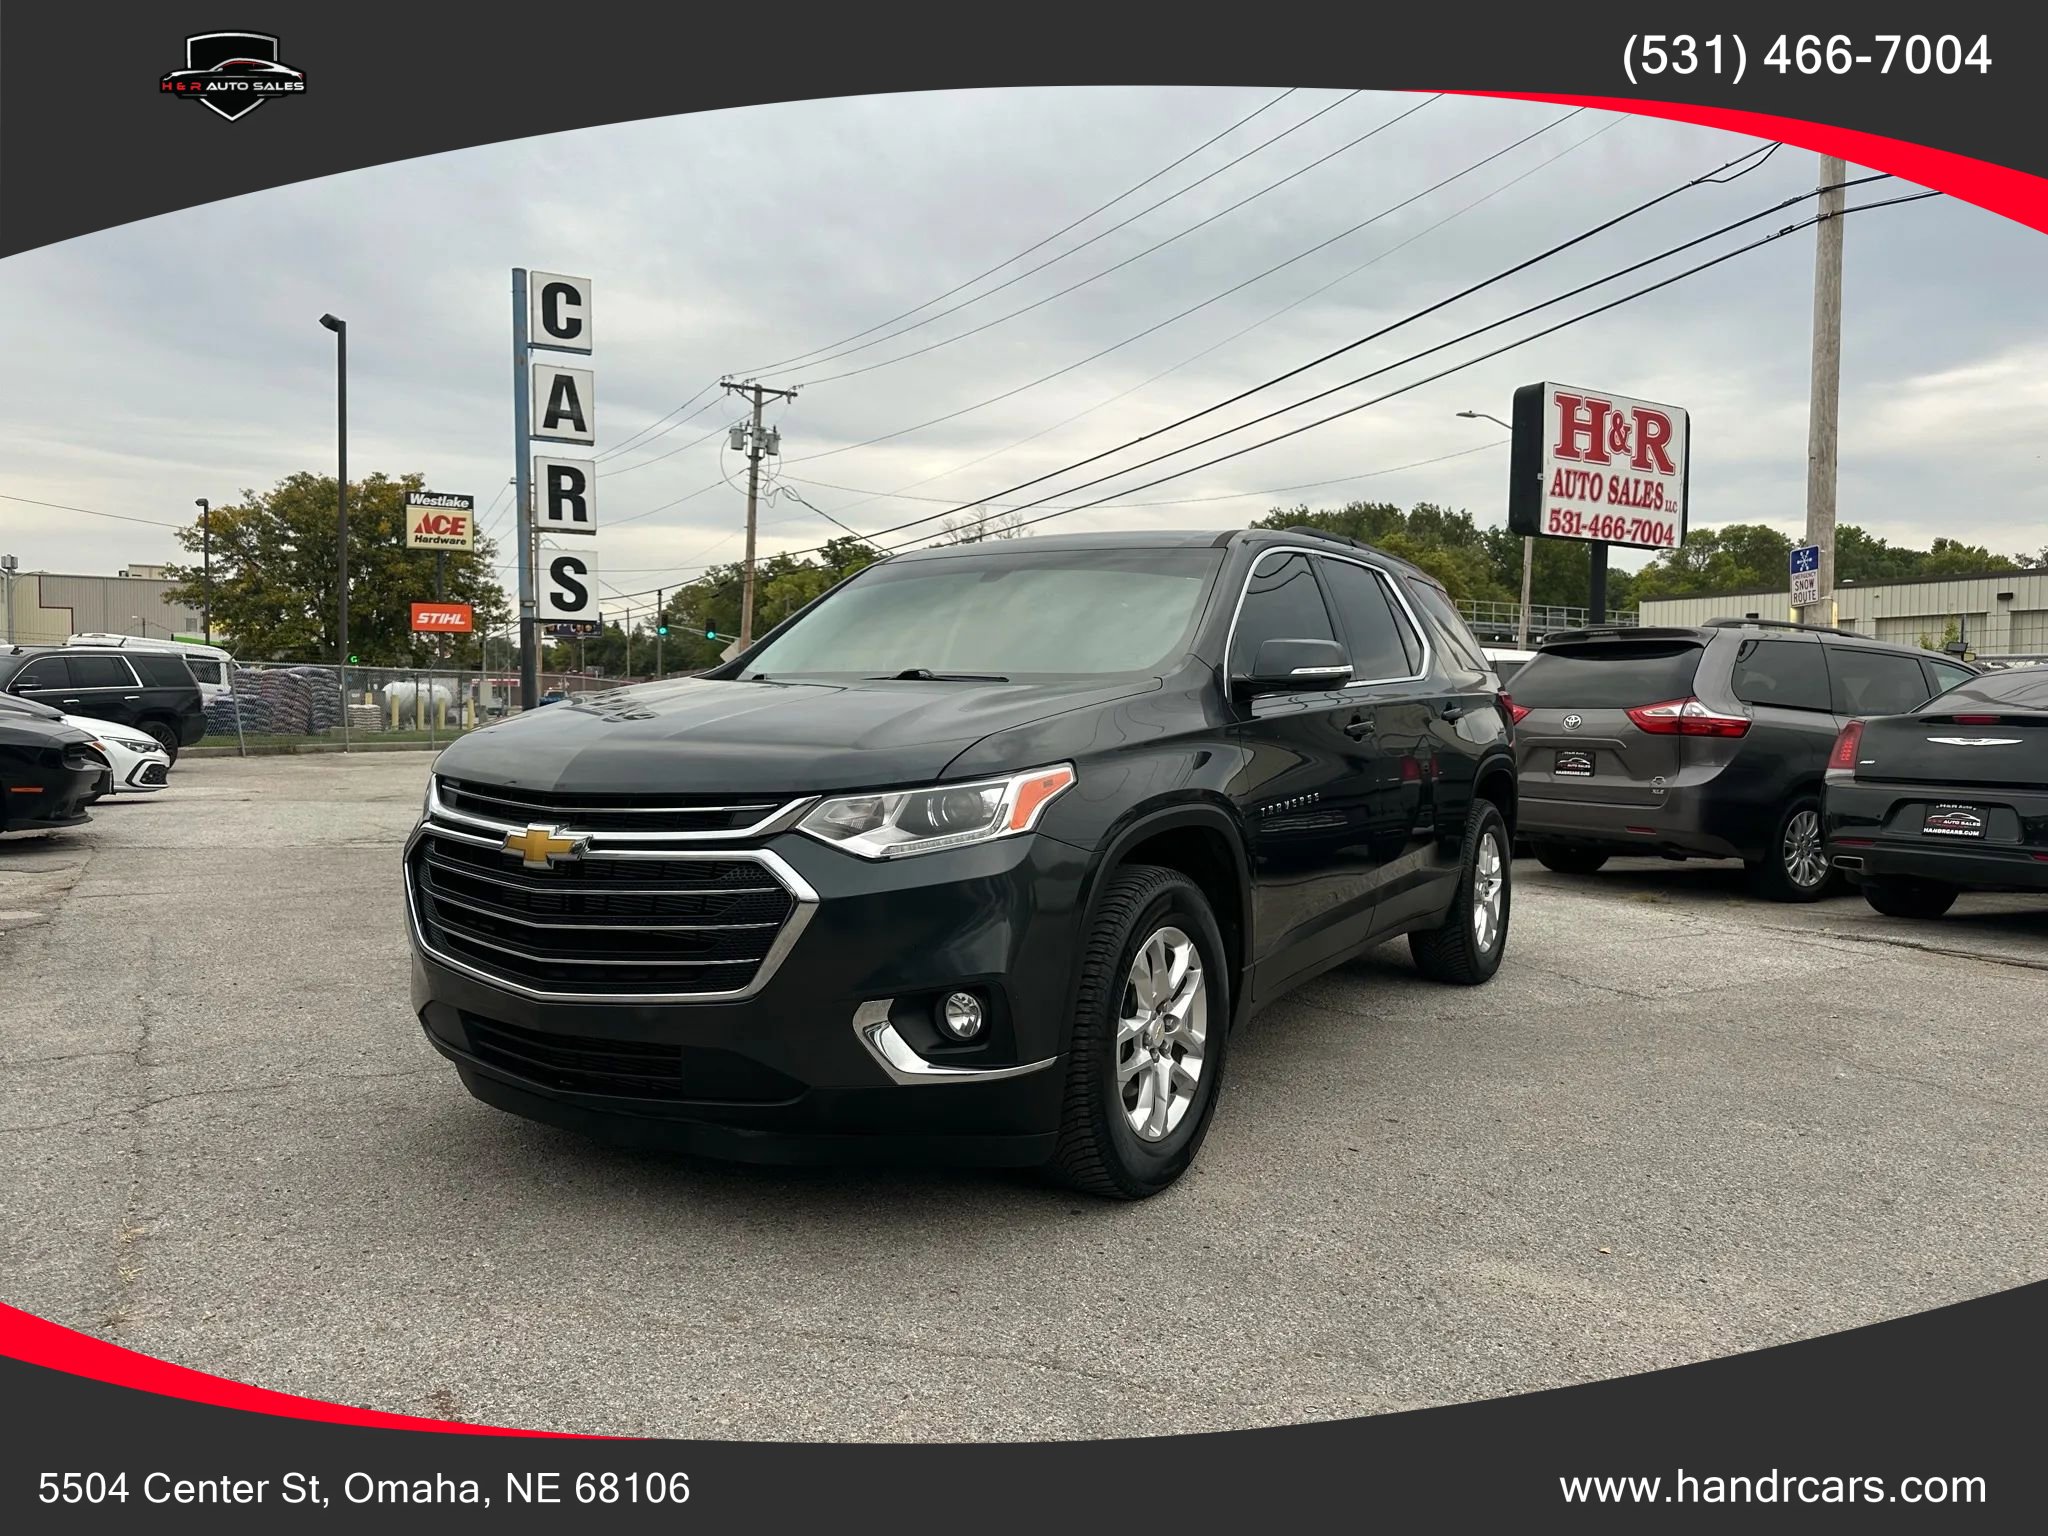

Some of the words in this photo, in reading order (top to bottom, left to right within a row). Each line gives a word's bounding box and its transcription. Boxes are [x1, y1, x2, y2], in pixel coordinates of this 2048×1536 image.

[1553, 391, 1676, 476] H&R
[1550, 467, 1604, 502] AUTO
[1607, 475, 1664, 511] SALES
[1665, 501, 1678, 514] LLC
[409, 493, 470, 508] Westlake
[414, 512, 467, 536] ACE
[1549, 507, 1674, 547] 531-466-7004
[414, 534, 467, 546] Hardware
[1794, 578, 1815, 592] SNOW
[1793, 589, 1817, 604] ROUTE
[416, 612, 466, 625] STIHL
[1260, 792, 1319, 817] TRAVERSE
